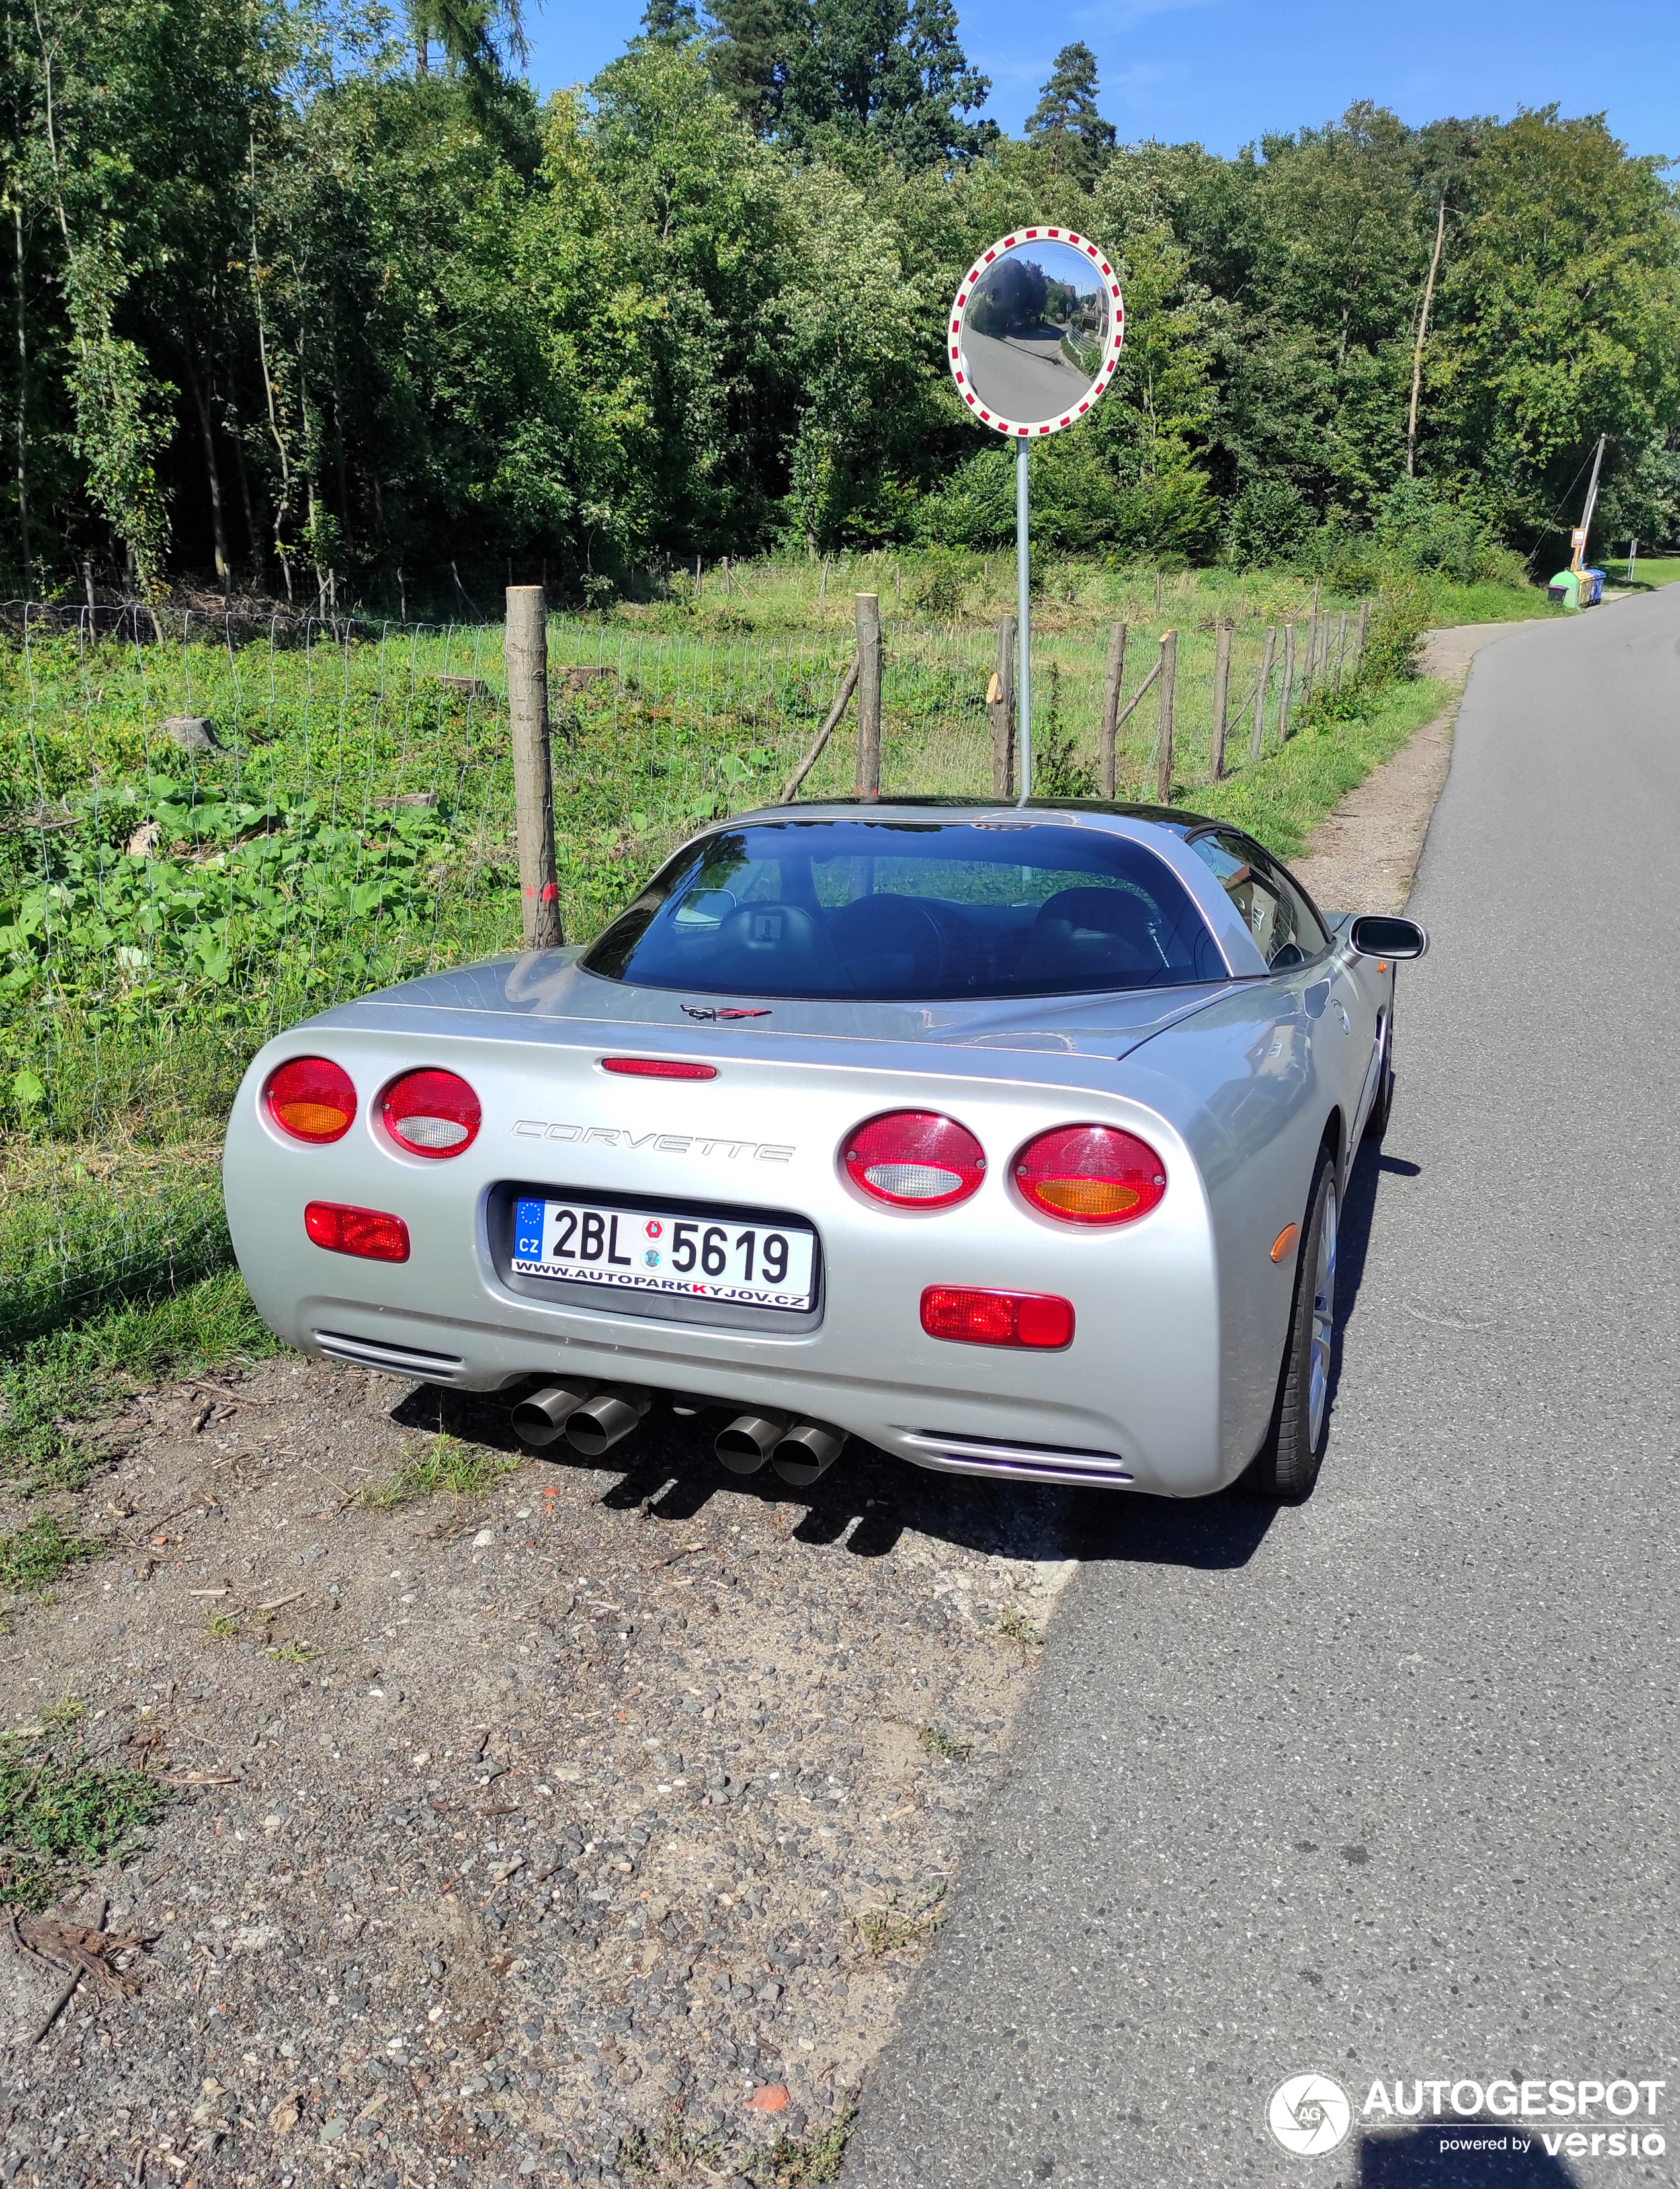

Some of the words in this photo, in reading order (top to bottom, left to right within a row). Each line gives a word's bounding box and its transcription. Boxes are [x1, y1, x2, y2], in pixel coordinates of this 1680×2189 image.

[509, 1119, 796, 1163] CORVETTE
[519, 1237, 539, 1253] CZ
[553, 1210, 632, 1266] 2BL
[672, 1222, 789, 1284] 5619
[516, 1261, 805, 1307] WWW.AUTOPARKKYJOV.CZ
